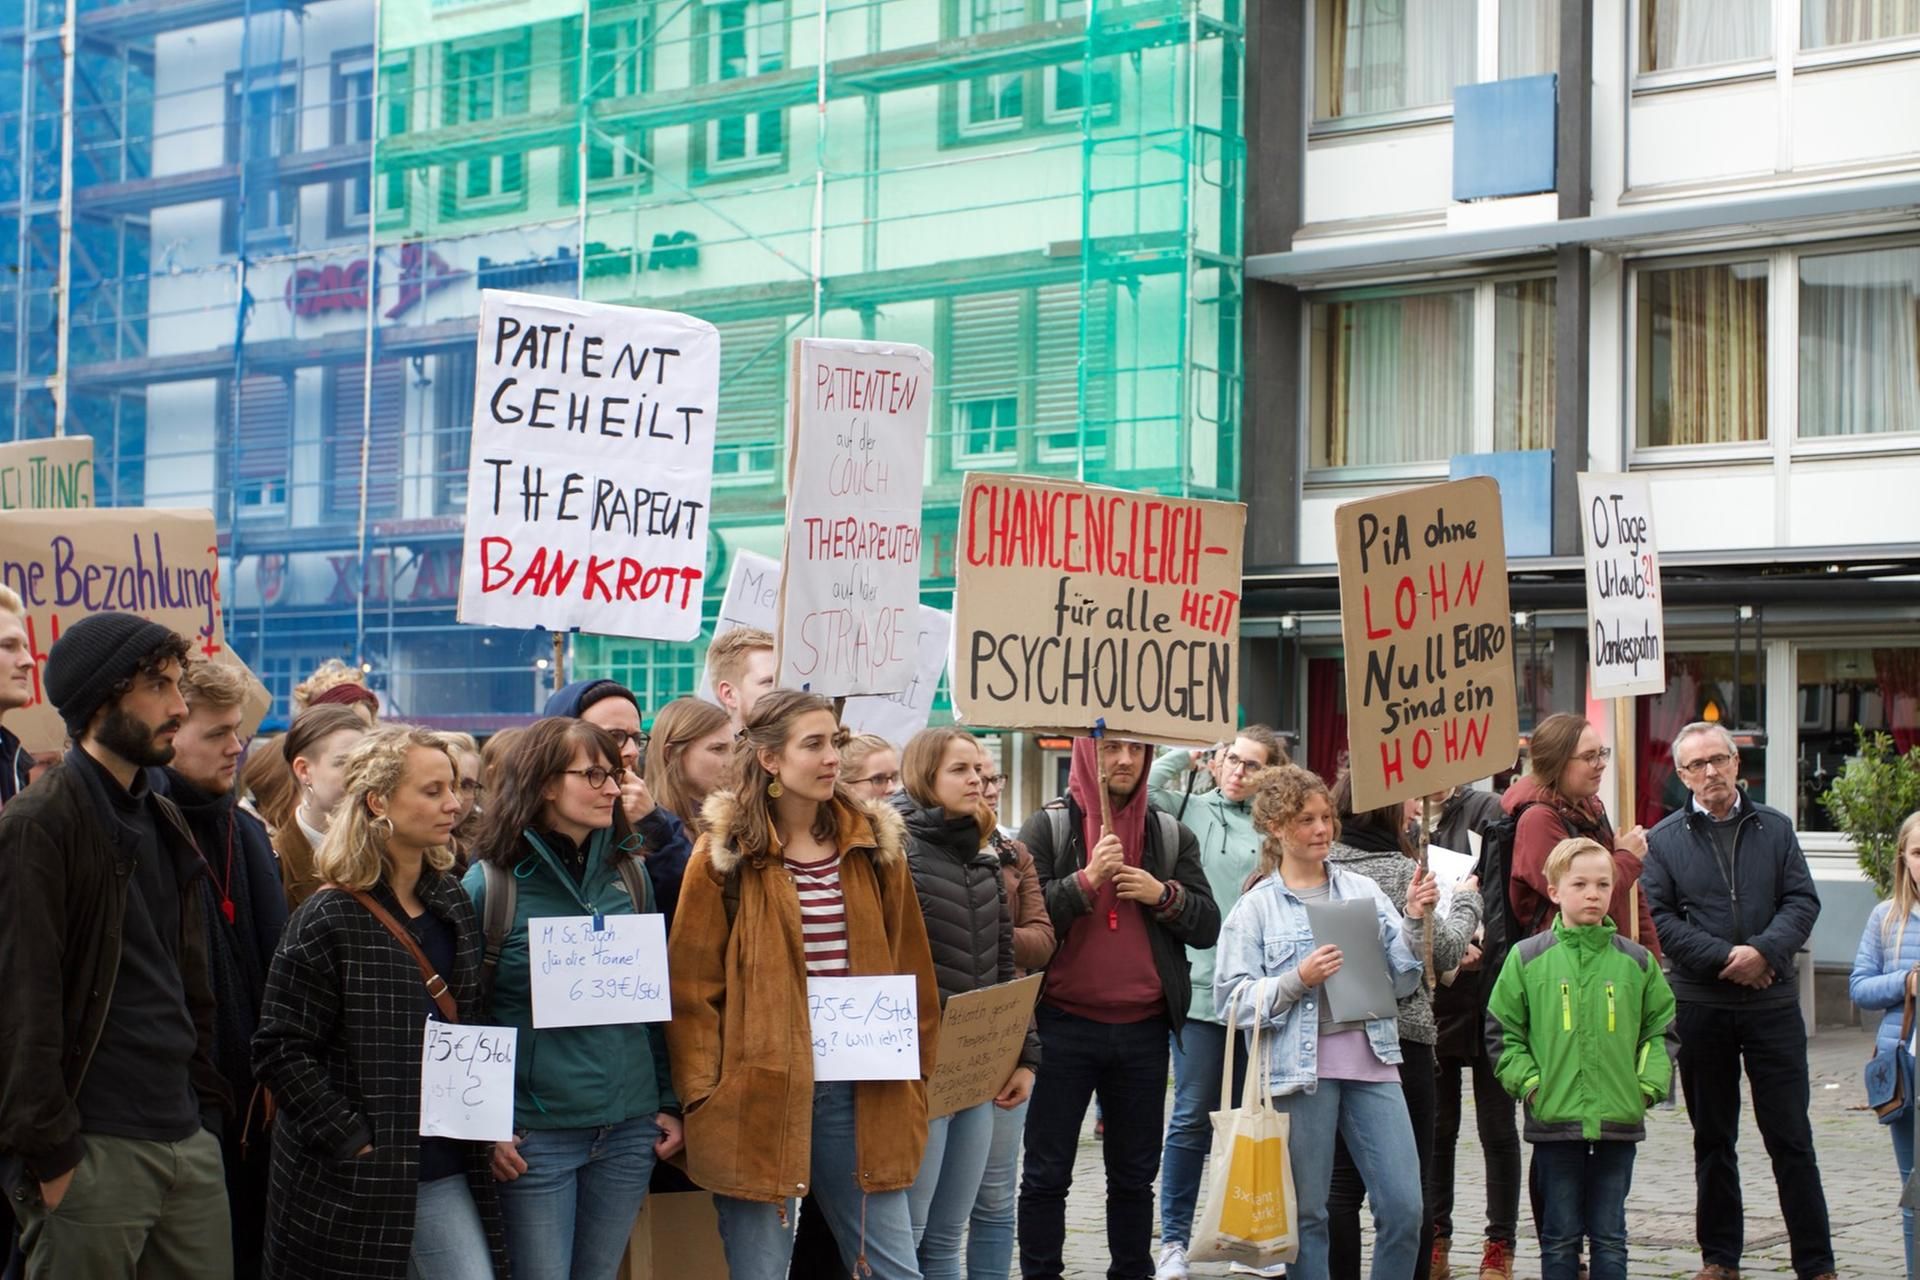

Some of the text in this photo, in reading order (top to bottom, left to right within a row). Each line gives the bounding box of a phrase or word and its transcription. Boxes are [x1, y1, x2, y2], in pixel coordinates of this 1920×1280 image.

[817, 364, 918, 413] PATIENTEN
[836, 418, 876, 451] auf der
[484, 459, 703, 539] THERAPEUT
[829, 454, 888, 496] COUCH
[804, 517, 921, 565] THERAPEUTEN
[967, 484, 1230, 585] CHANCENGLEICH-
[1358, 508, 1477, 573] PiA ohne
[1610, 495, 1647, 556] Tage
[481, 537, 702, 609] BANKROTT
[833, 563, 858, 606] auf
[1364, 560, 1484, 640] LOHN
[1054, 577, 1172, 636] für alle
[1180, 588, 1238, 637] HEIT
[971, 630, 1230, 723] PSYCHOLOGEN
[1363, 623, 1505, 706] Null EURO
[1595, 619, 1659, 676] Dankespahn
[1454, 679, 1493, 713] ein
[1381, 714, 1490, 791] HOHN
[566, 950, 586, 966] die
